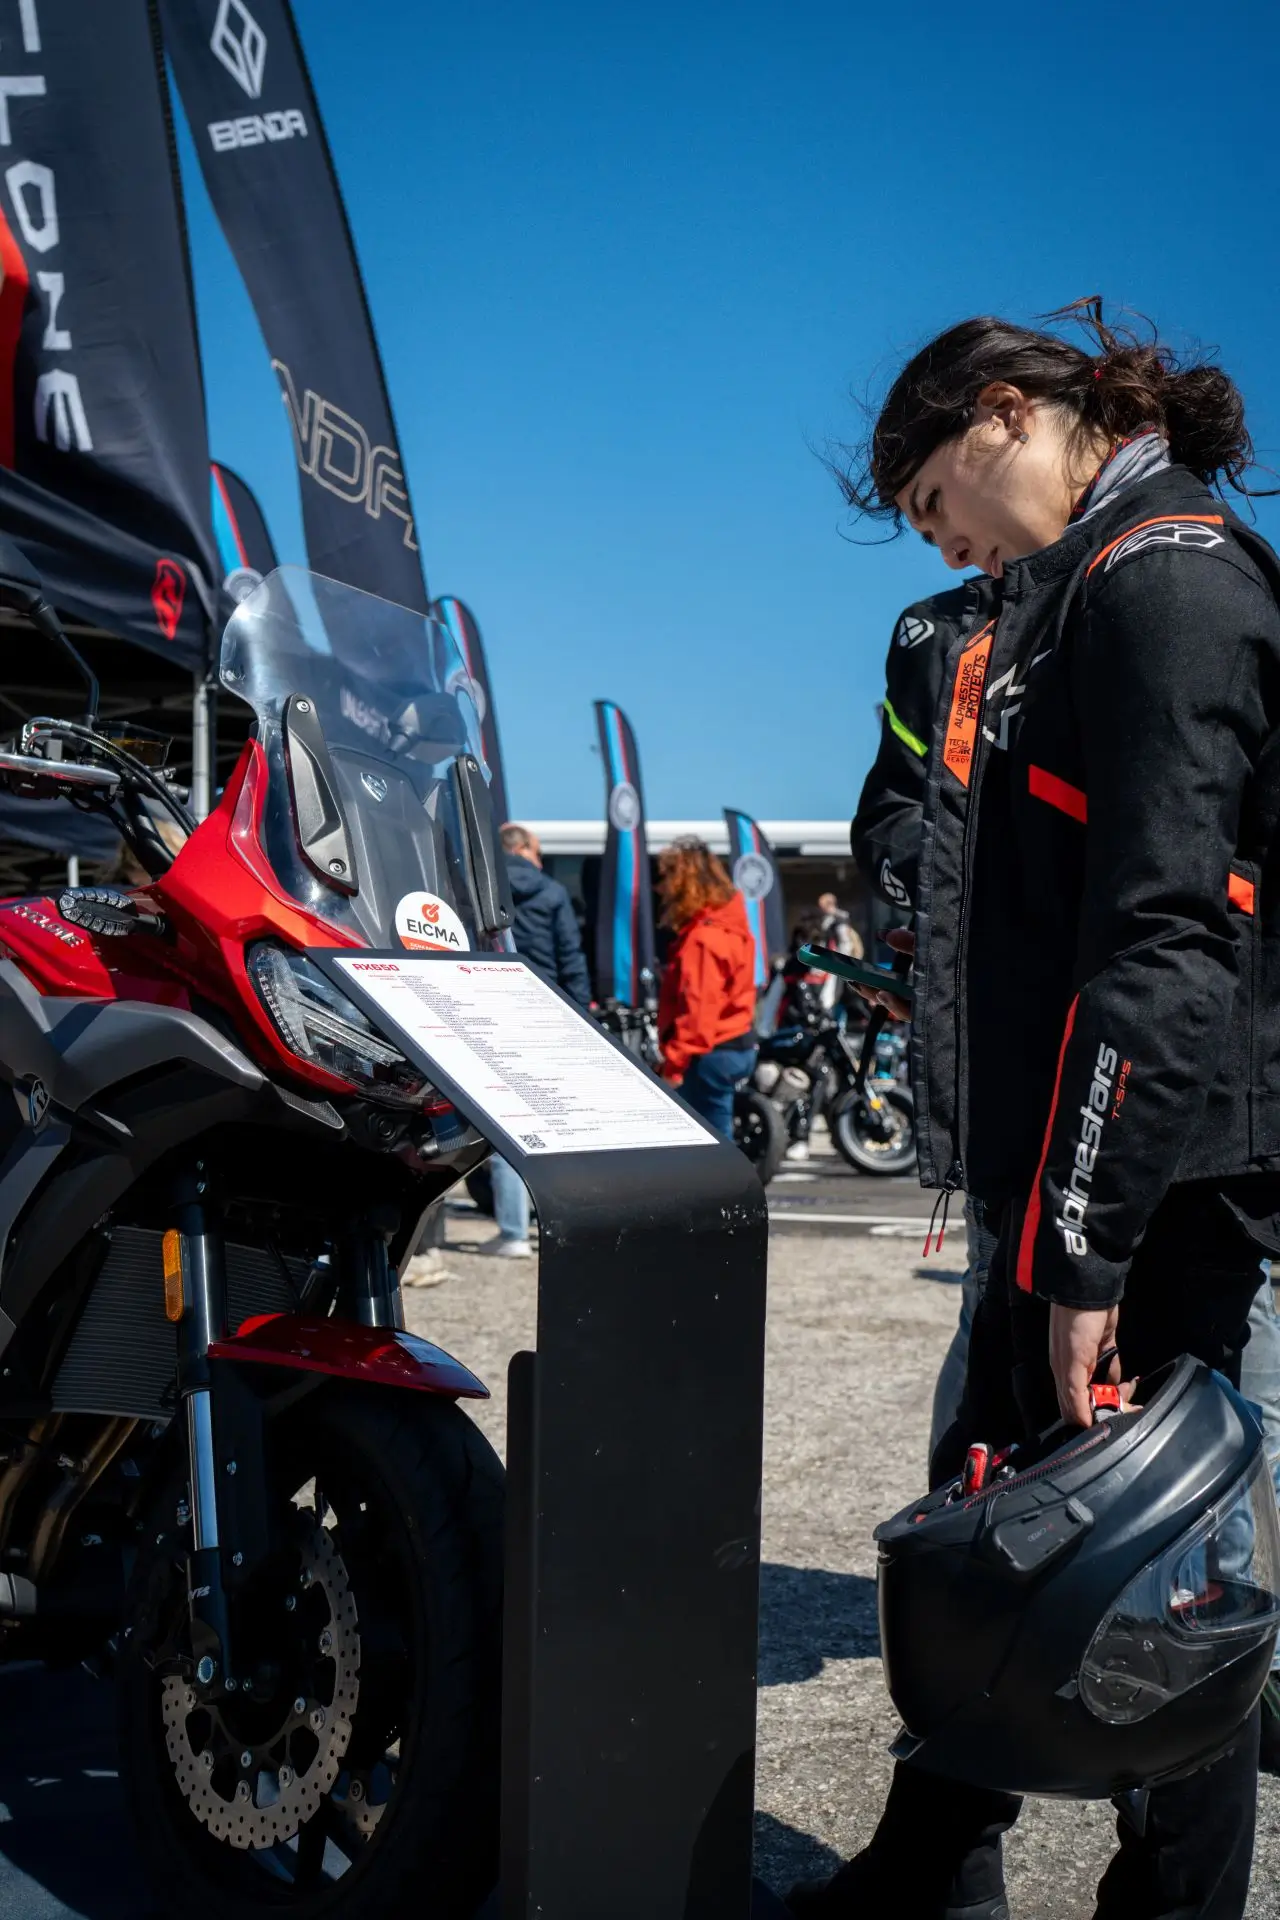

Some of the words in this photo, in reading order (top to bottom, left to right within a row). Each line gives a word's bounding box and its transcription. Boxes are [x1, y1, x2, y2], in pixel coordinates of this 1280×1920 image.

[207, 109, 308, 152] BENDA
[954, 662, 972, 729] ALPINESTARS
[965, 654, 986, 720] PROTECTS
[406, 918, 460, 946] EICMA
[352, 963, 400, 971] RX650
[1111, 1059, 1132, 1121] T-SPS
[1055, 1042, 1118, 1256] alpinestars
